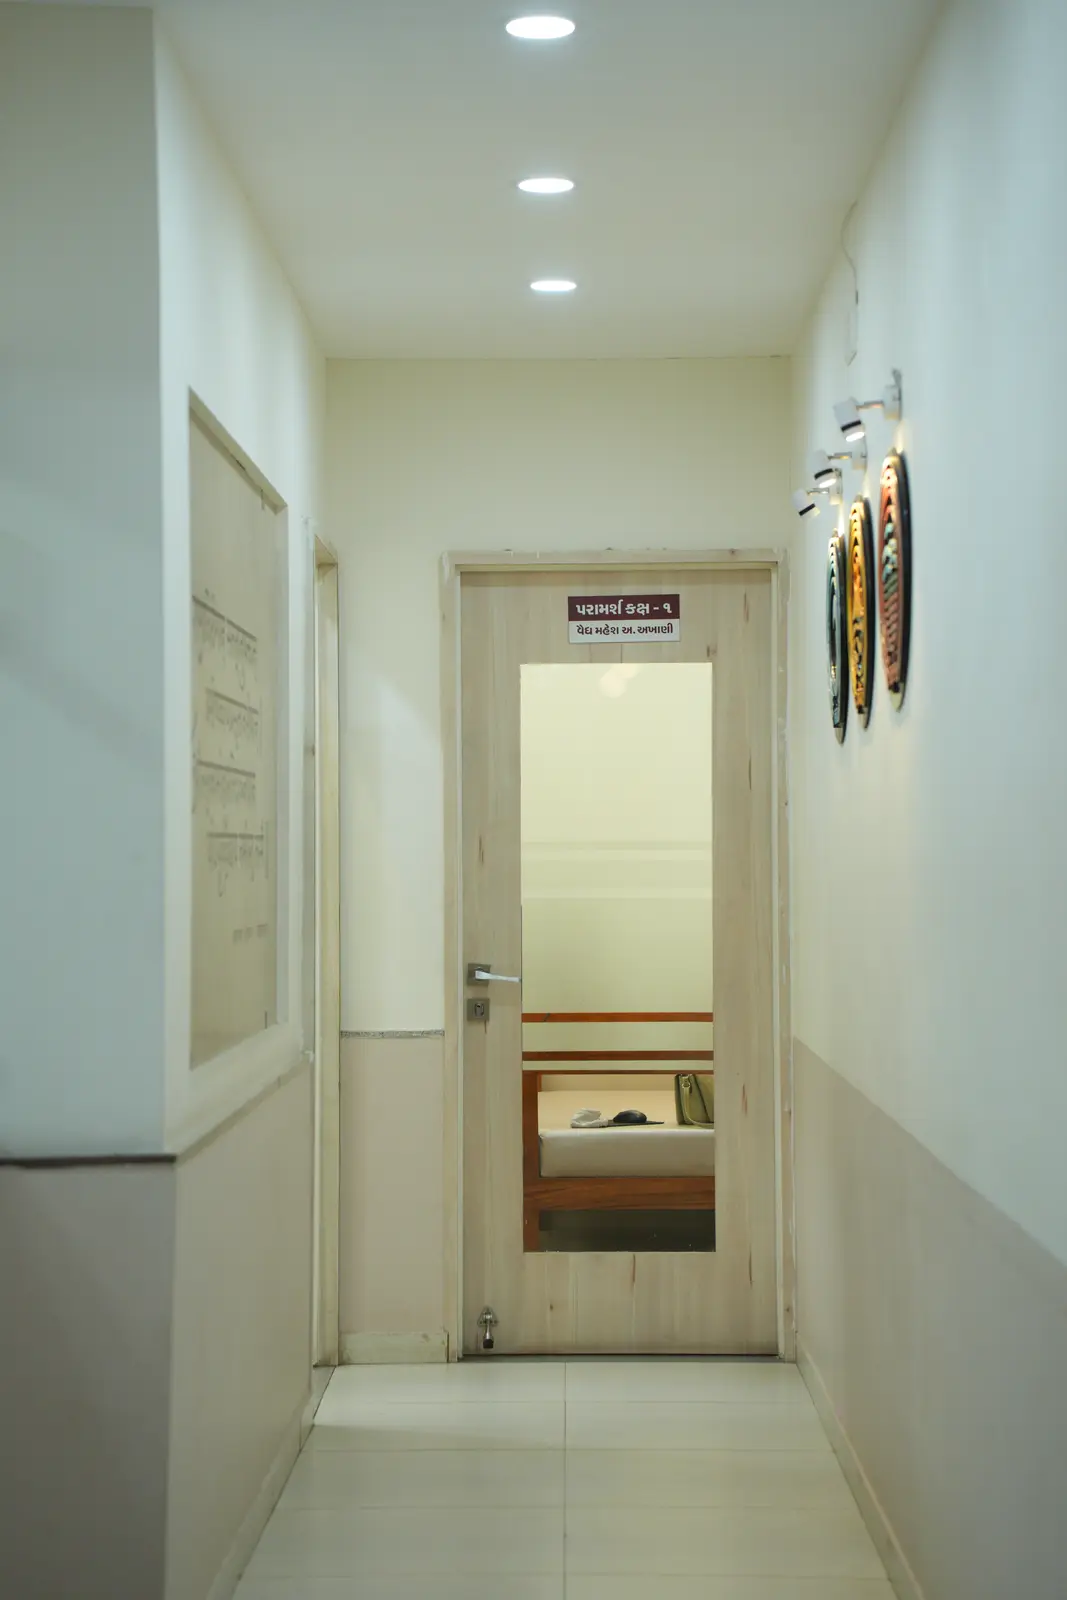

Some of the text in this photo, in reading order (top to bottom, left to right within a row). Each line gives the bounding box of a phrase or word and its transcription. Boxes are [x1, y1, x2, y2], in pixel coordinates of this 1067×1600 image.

[576, 599, 623, 615] પરામર્શ
[625, 602, 649, 616] કક્ષ
[663, 602, 673, 613] ૧
[595, 623, 619, 636] મહેશ
[637, 622, 674, 634] અખાણી
